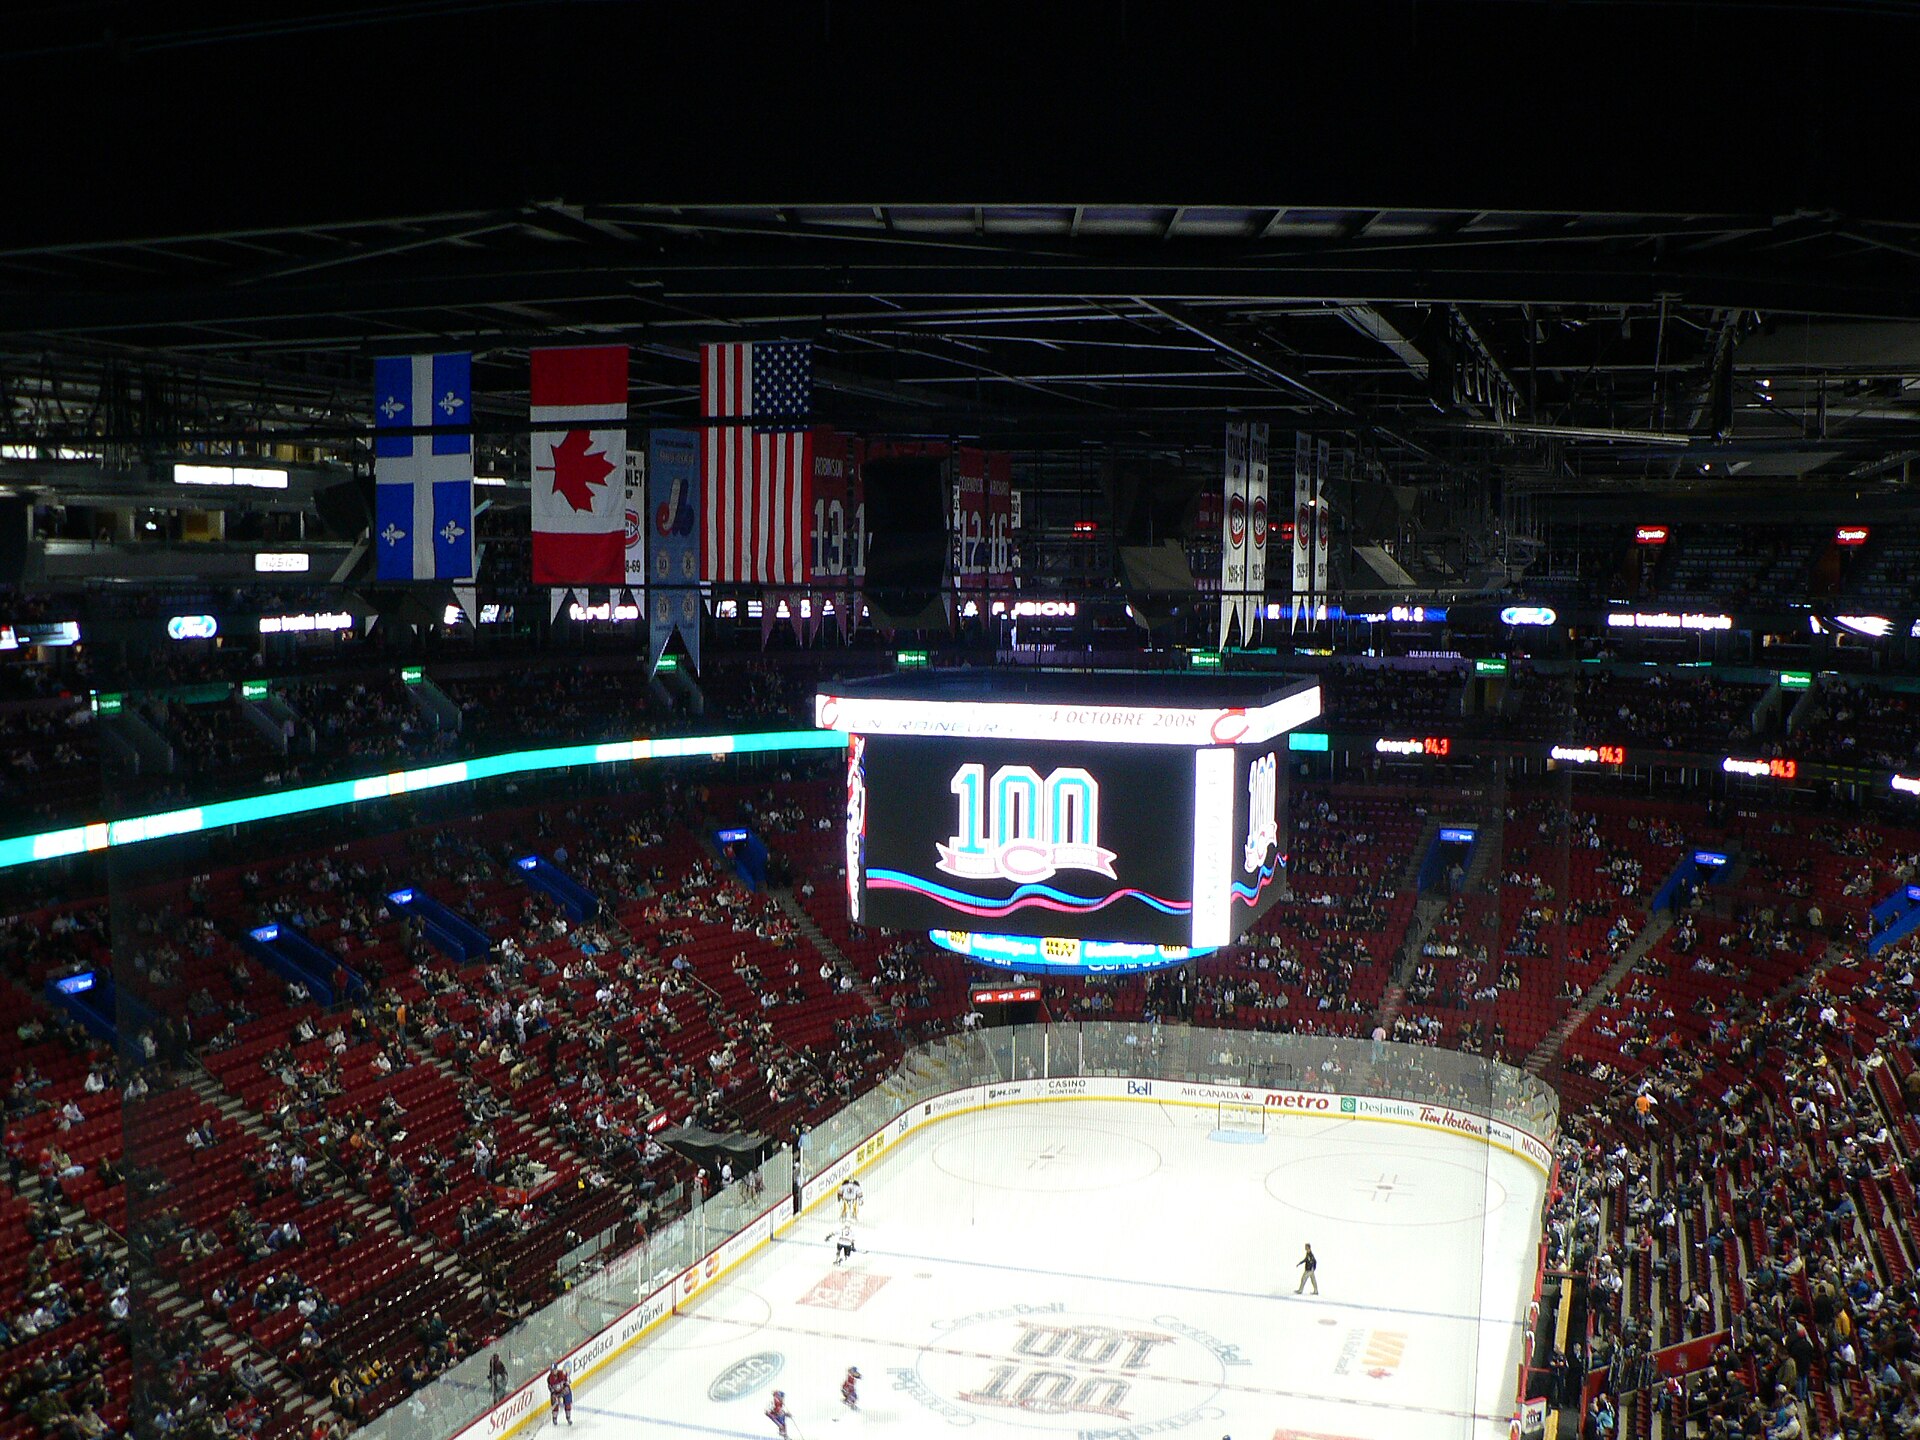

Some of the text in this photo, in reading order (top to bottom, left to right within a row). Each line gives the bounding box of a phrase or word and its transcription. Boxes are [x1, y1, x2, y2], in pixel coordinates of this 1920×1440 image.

[626, 469, 643, 487] NLEY
[960, 510, 982, 575] 12
[989, 511, 1009, 575] 16
[1065, 711, 1144, 727] OCTOBRE
[1152, 713, 1196, 734] 2008
[1425, 738, 1449, 756] 94.3
[1600, 746, 1624, 764] 94.3
[1771, 760, 1797, 778] 94.3
[951, 764, 1099, 855] 100
[1048, 1079, 1087, 1089] CASINO
[1127, 1080, 1152, 1096] Bell
[1181, 1087, 1240, 1101] AIR CANADA
[1264, 1093, 1330, 1110] metro
[1359, 1101, 1416, 1117] Desjardins
[1419, 1105, 1485, 1135] Tim Hortons
[976, 1366, 1133, 1410] 100
[488, 1390, 535, 1435] Saputo
